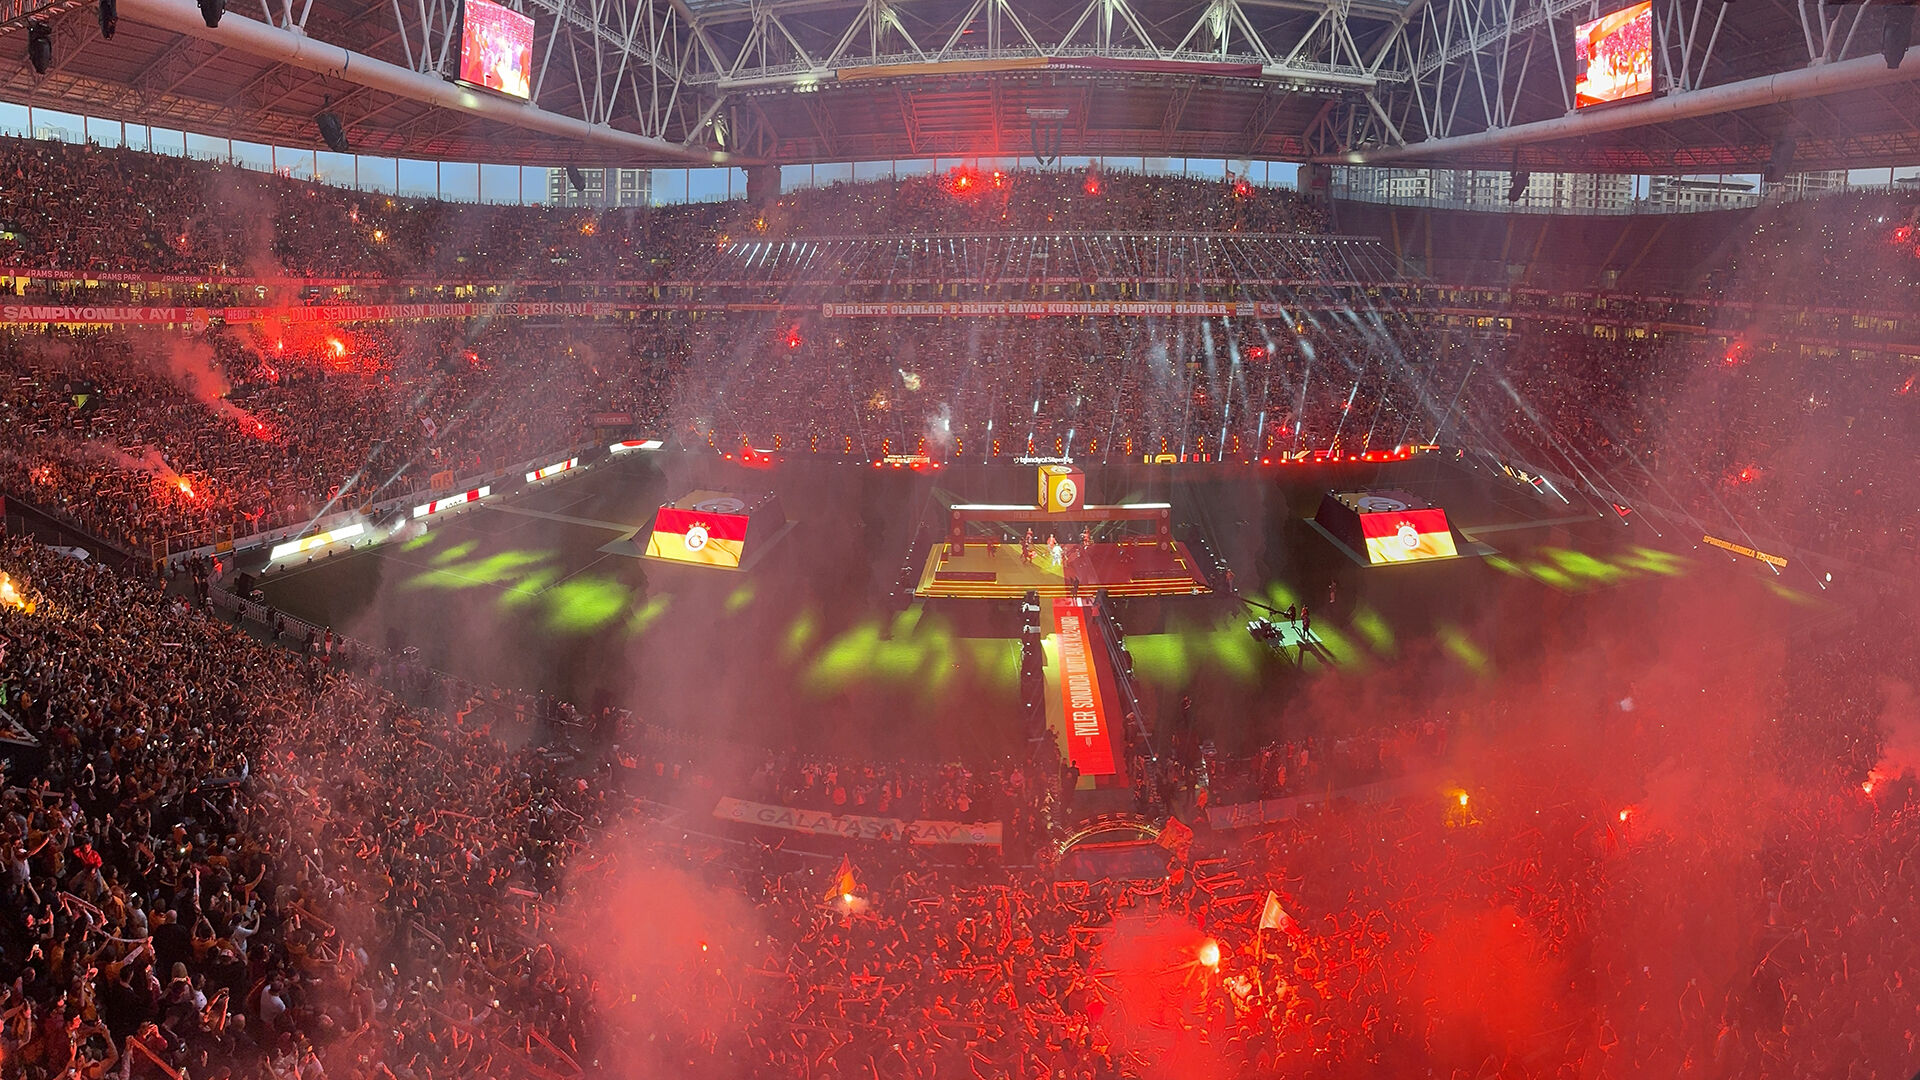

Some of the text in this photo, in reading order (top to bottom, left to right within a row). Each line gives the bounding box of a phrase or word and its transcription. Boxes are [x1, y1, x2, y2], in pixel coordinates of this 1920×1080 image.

[31, 270, 74, 279] RAMS PARK
[103, 273, 141, 282] RAMS PARK
[3, 306, 144, 322] ŞAMPİYONLUK
[149, 308, 176, 320] AYI
[227, 309, 250, 320] HEDEF
[471, 303, 518, 315] HERKES
[835, 304, 888, 315] BİRLİKTE
[1008, 303, 1044, 313] HAYAL
[1048, 303, 1109, 313] KURANLAR
[1113, 302, 1172, 315] ŞAMPİYON
[1175, 303, 1230, 314] OLURLAR.
[1065, 641, 1088, 673] MUTLAKA
[1069, 674, 1095, 708] SONUNDA
[1073, 711, 1100, 736] İYİLER
[756, 808, 961, 840] GALATASARAY
